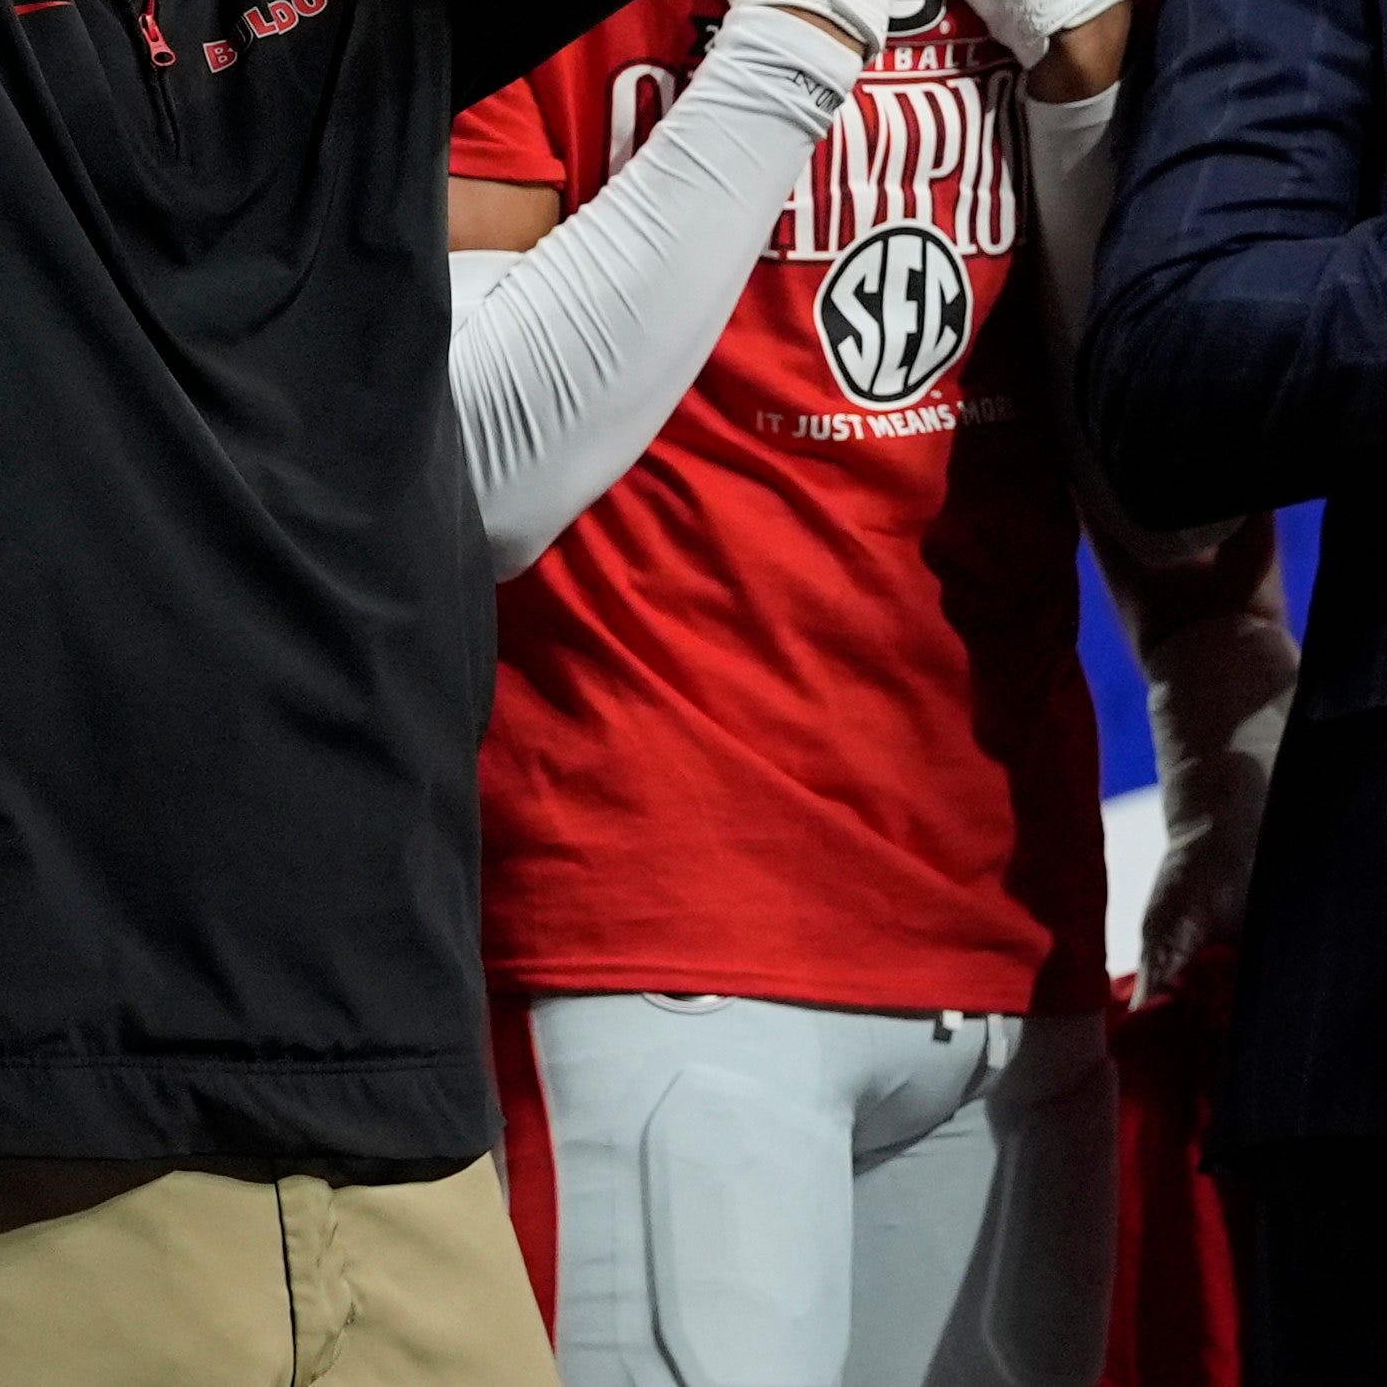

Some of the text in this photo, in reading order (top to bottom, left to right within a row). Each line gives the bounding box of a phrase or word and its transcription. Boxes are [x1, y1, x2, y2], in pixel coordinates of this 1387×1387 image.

[829, 232, 961, 397] SEC
[754, 409, 785, 435] IT
[791, 412, 867, 443] JUST
[867, 403, 958, 439] MEANS
